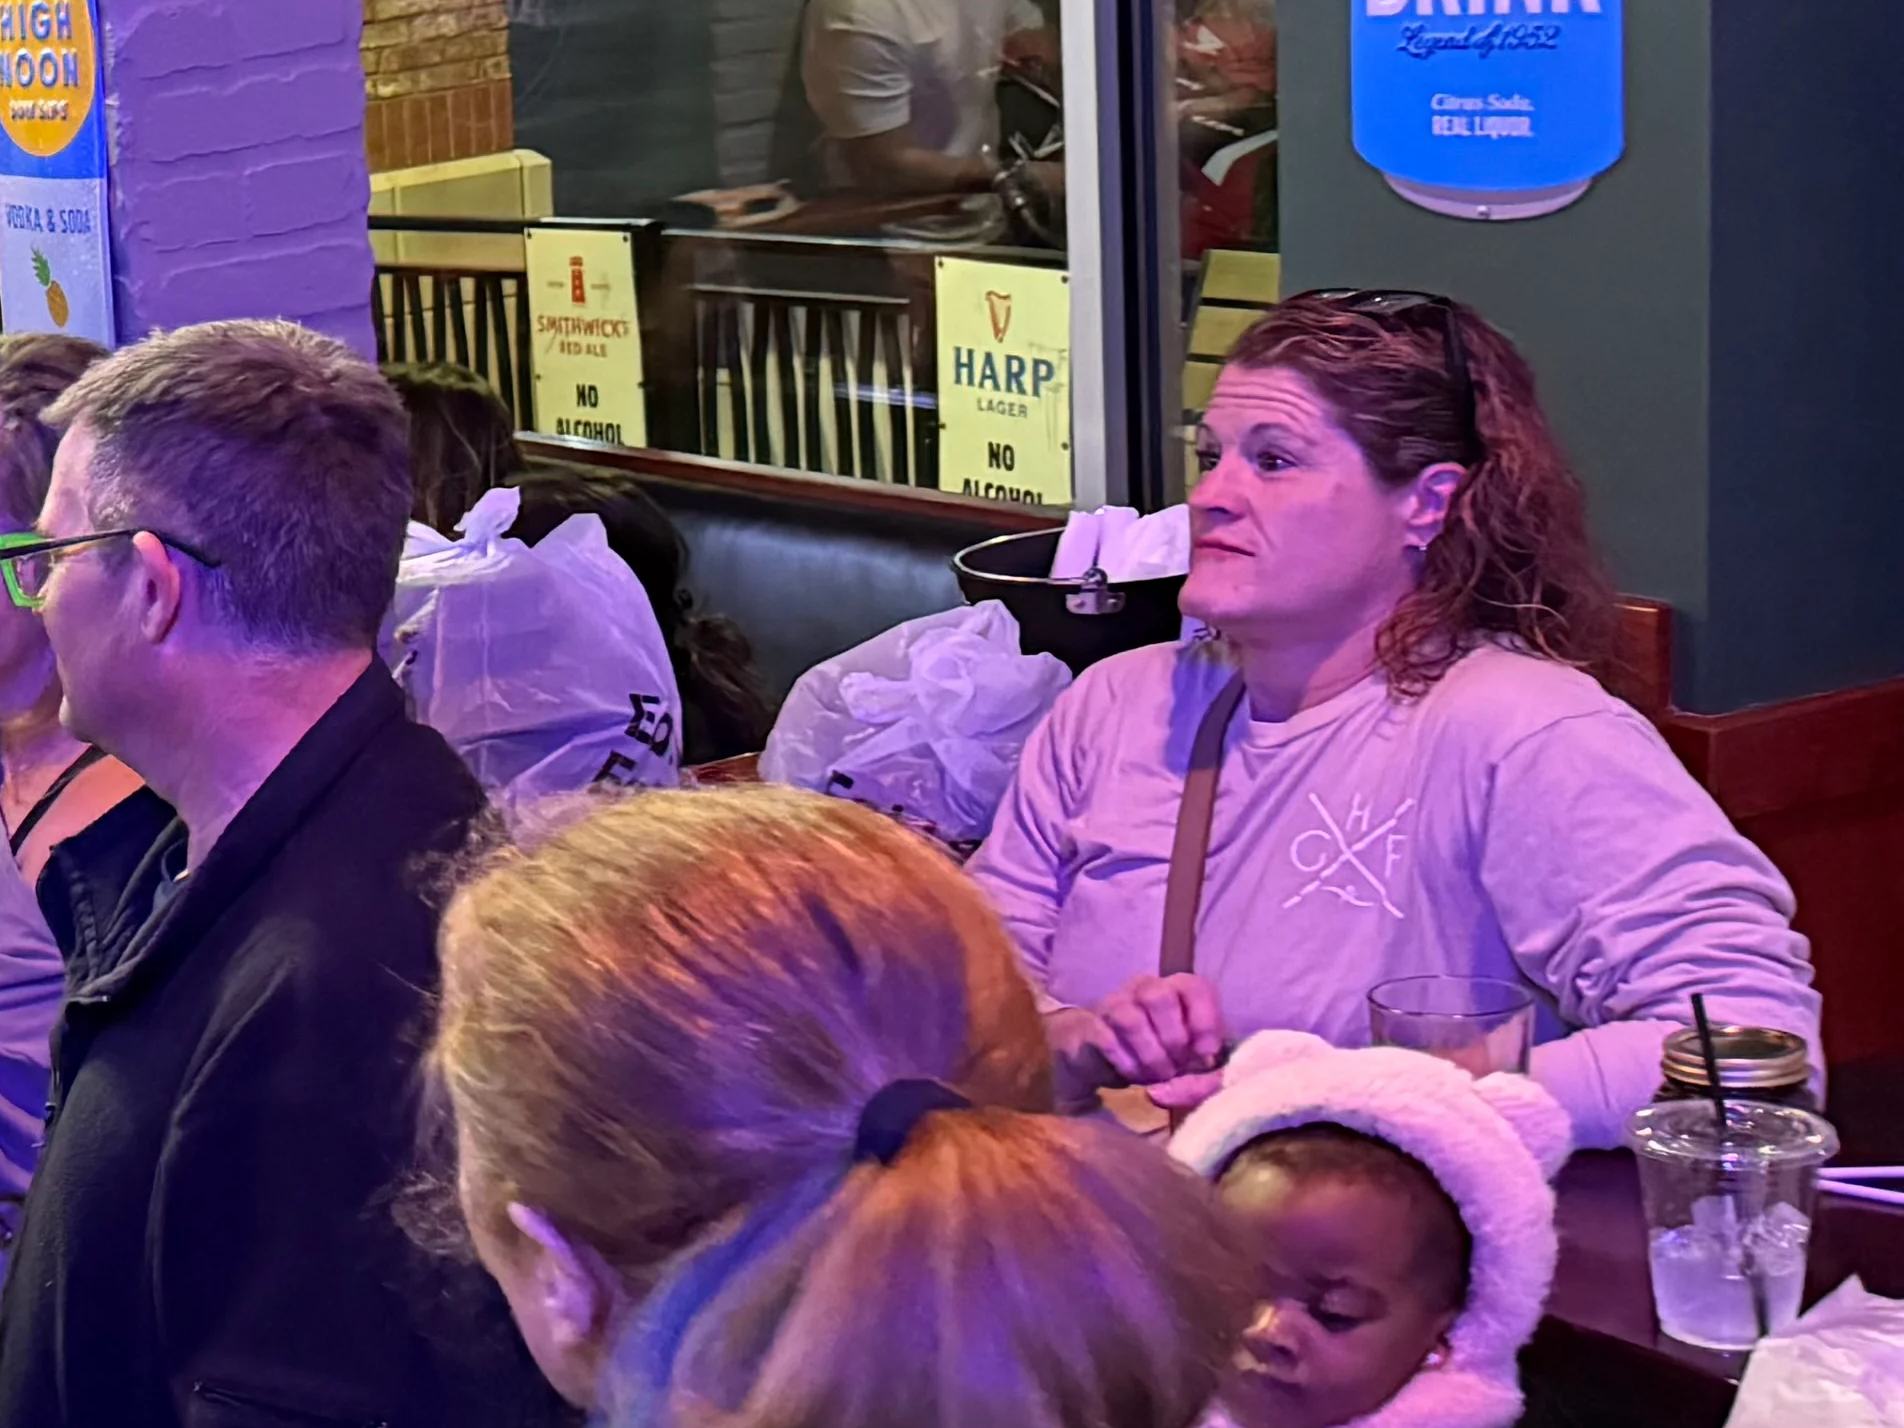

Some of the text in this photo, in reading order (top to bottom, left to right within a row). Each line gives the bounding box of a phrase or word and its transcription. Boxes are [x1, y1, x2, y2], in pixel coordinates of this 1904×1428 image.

[584, 343, 607, 358] ALE
[953, 345, 1056, 399] HARP
[576, 383, 600, 409] NO
[977, 398, 1028, 419] LAGER
[987, 441, 1016, 472] NO
